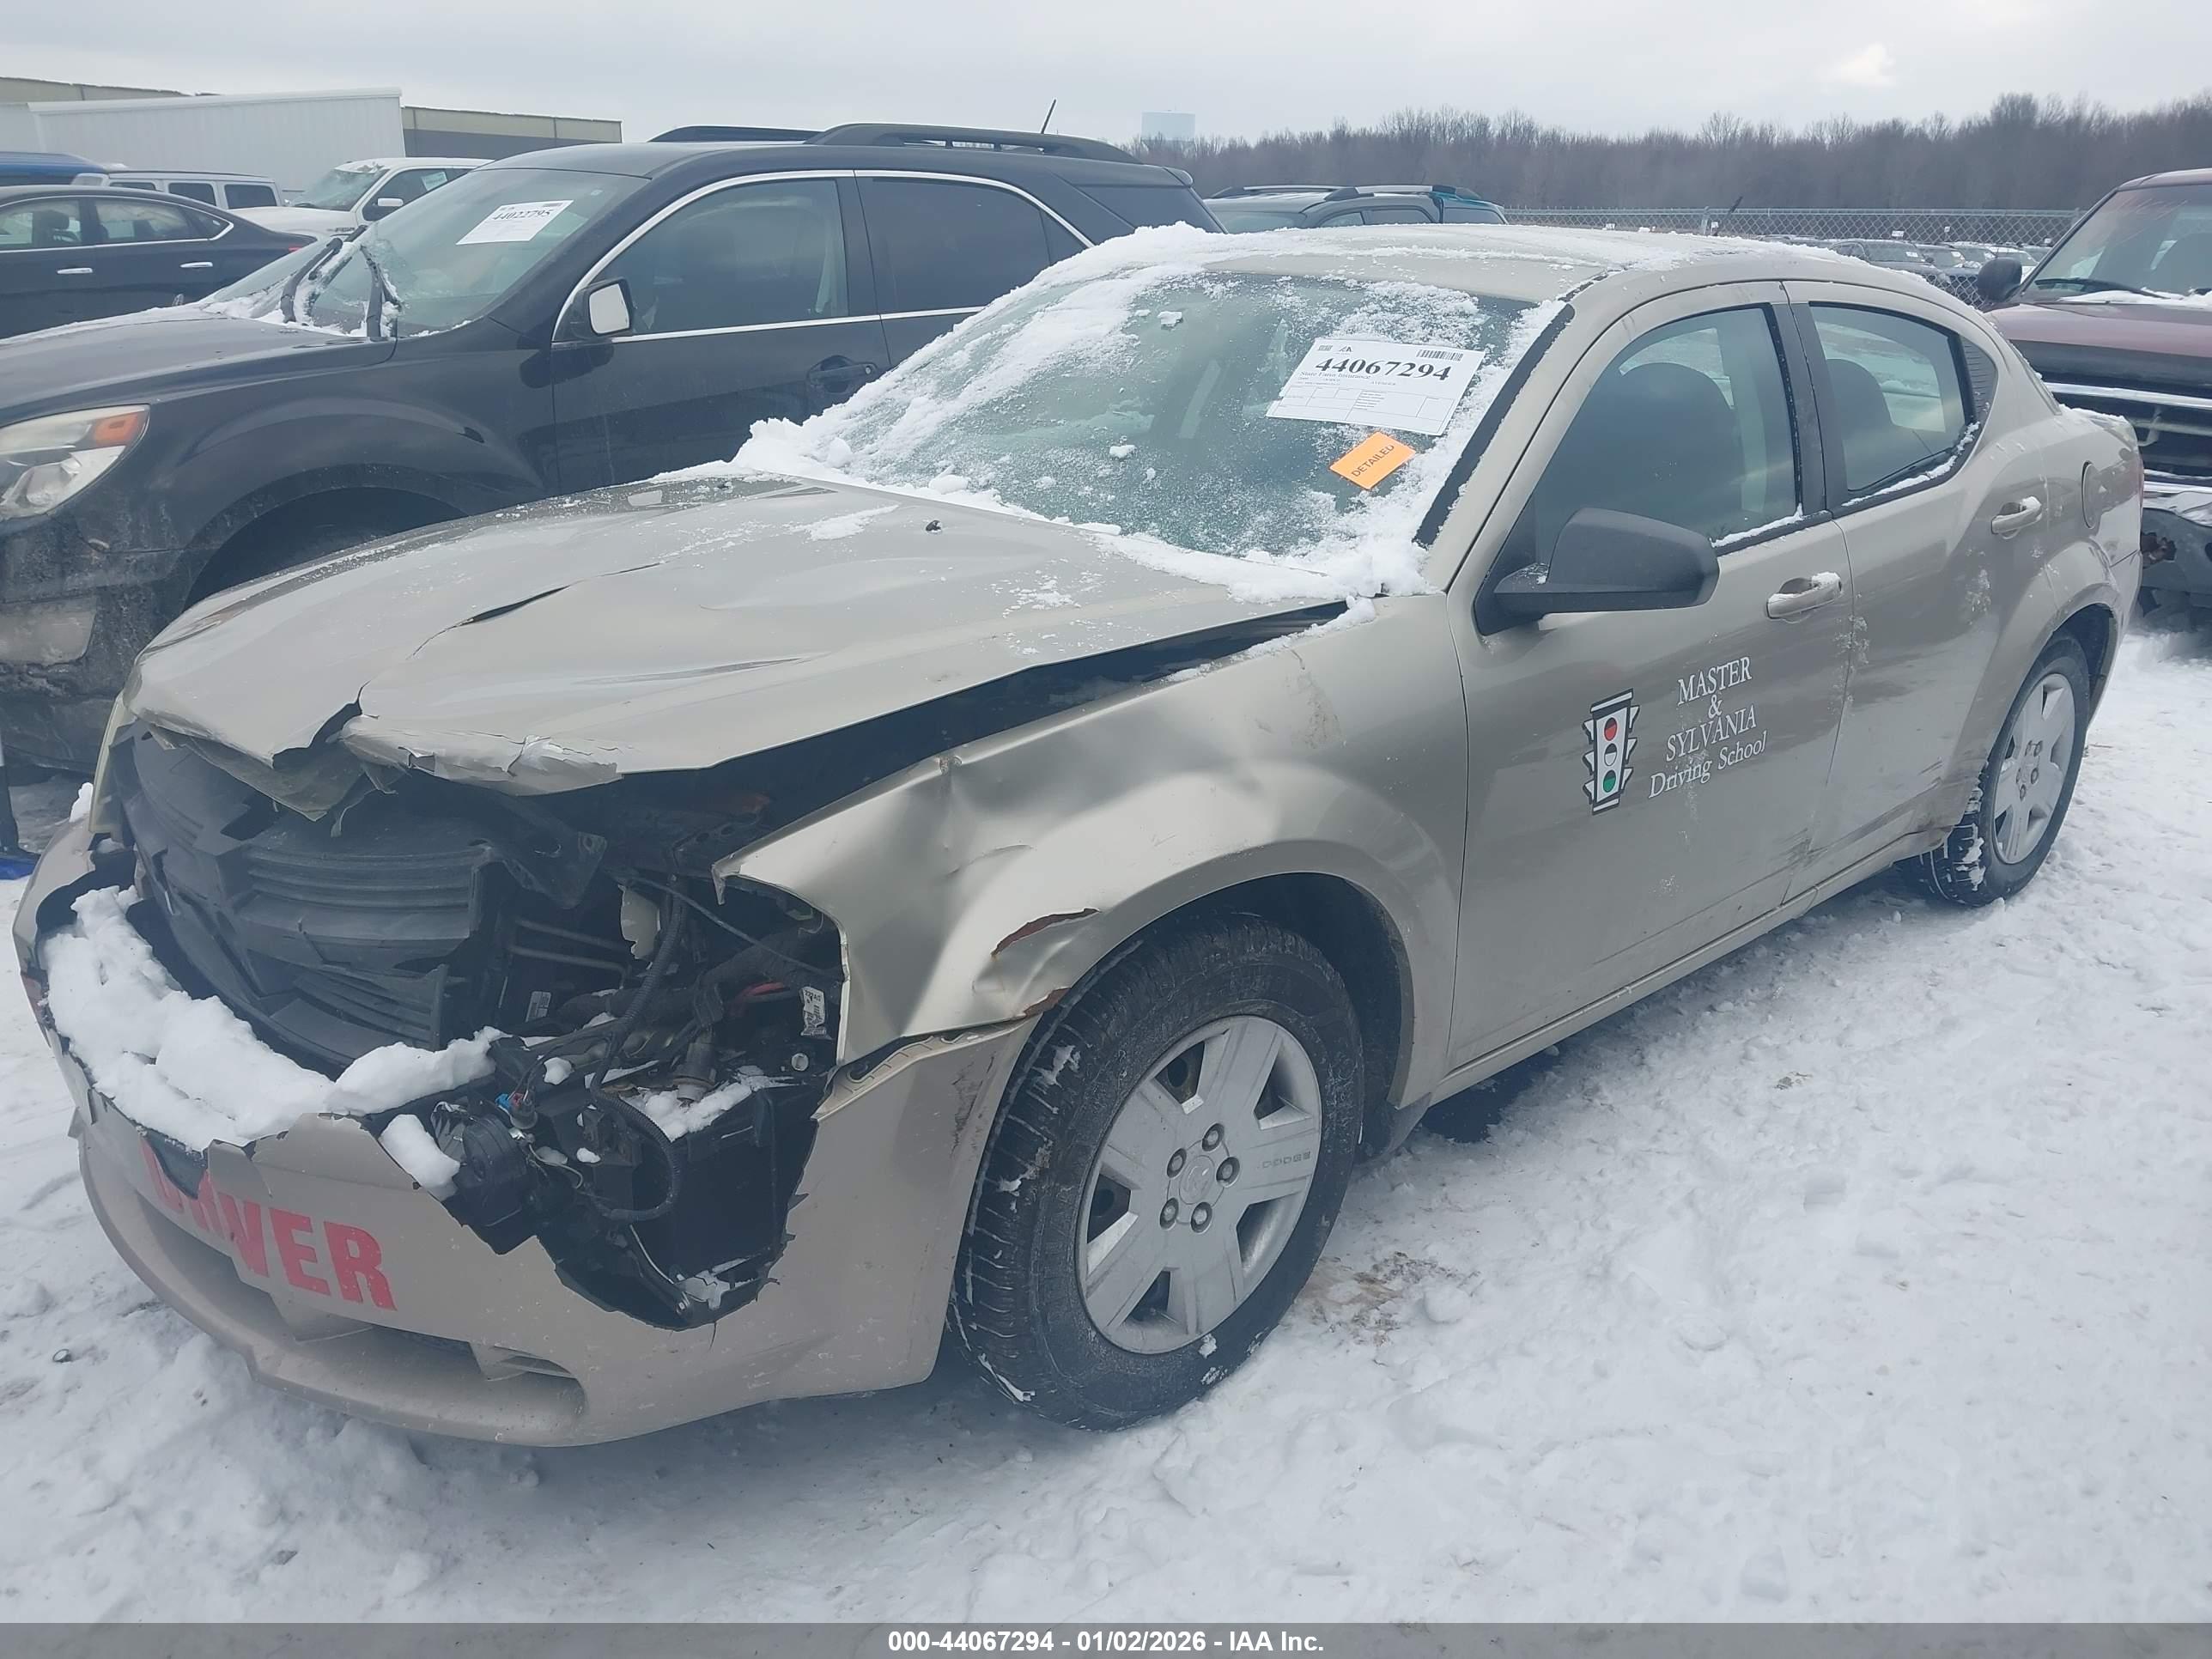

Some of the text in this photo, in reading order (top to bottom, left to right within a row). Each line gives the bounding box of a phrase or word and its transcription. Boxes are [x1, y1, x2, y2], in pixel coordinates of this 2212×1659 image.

[1315, 357, 1453, 380] 44067294
[1351, 444, 1395, 477] DETAILED
[1677, 656, 1753, 706] MASTER
[1708, 694, 1723, 719] &
[1666, 704, 1757, 762] SYLVANIA
[1649, 730, 1766, 799] Driving School
[1262, 1151, 1310, 1169] DODGE
